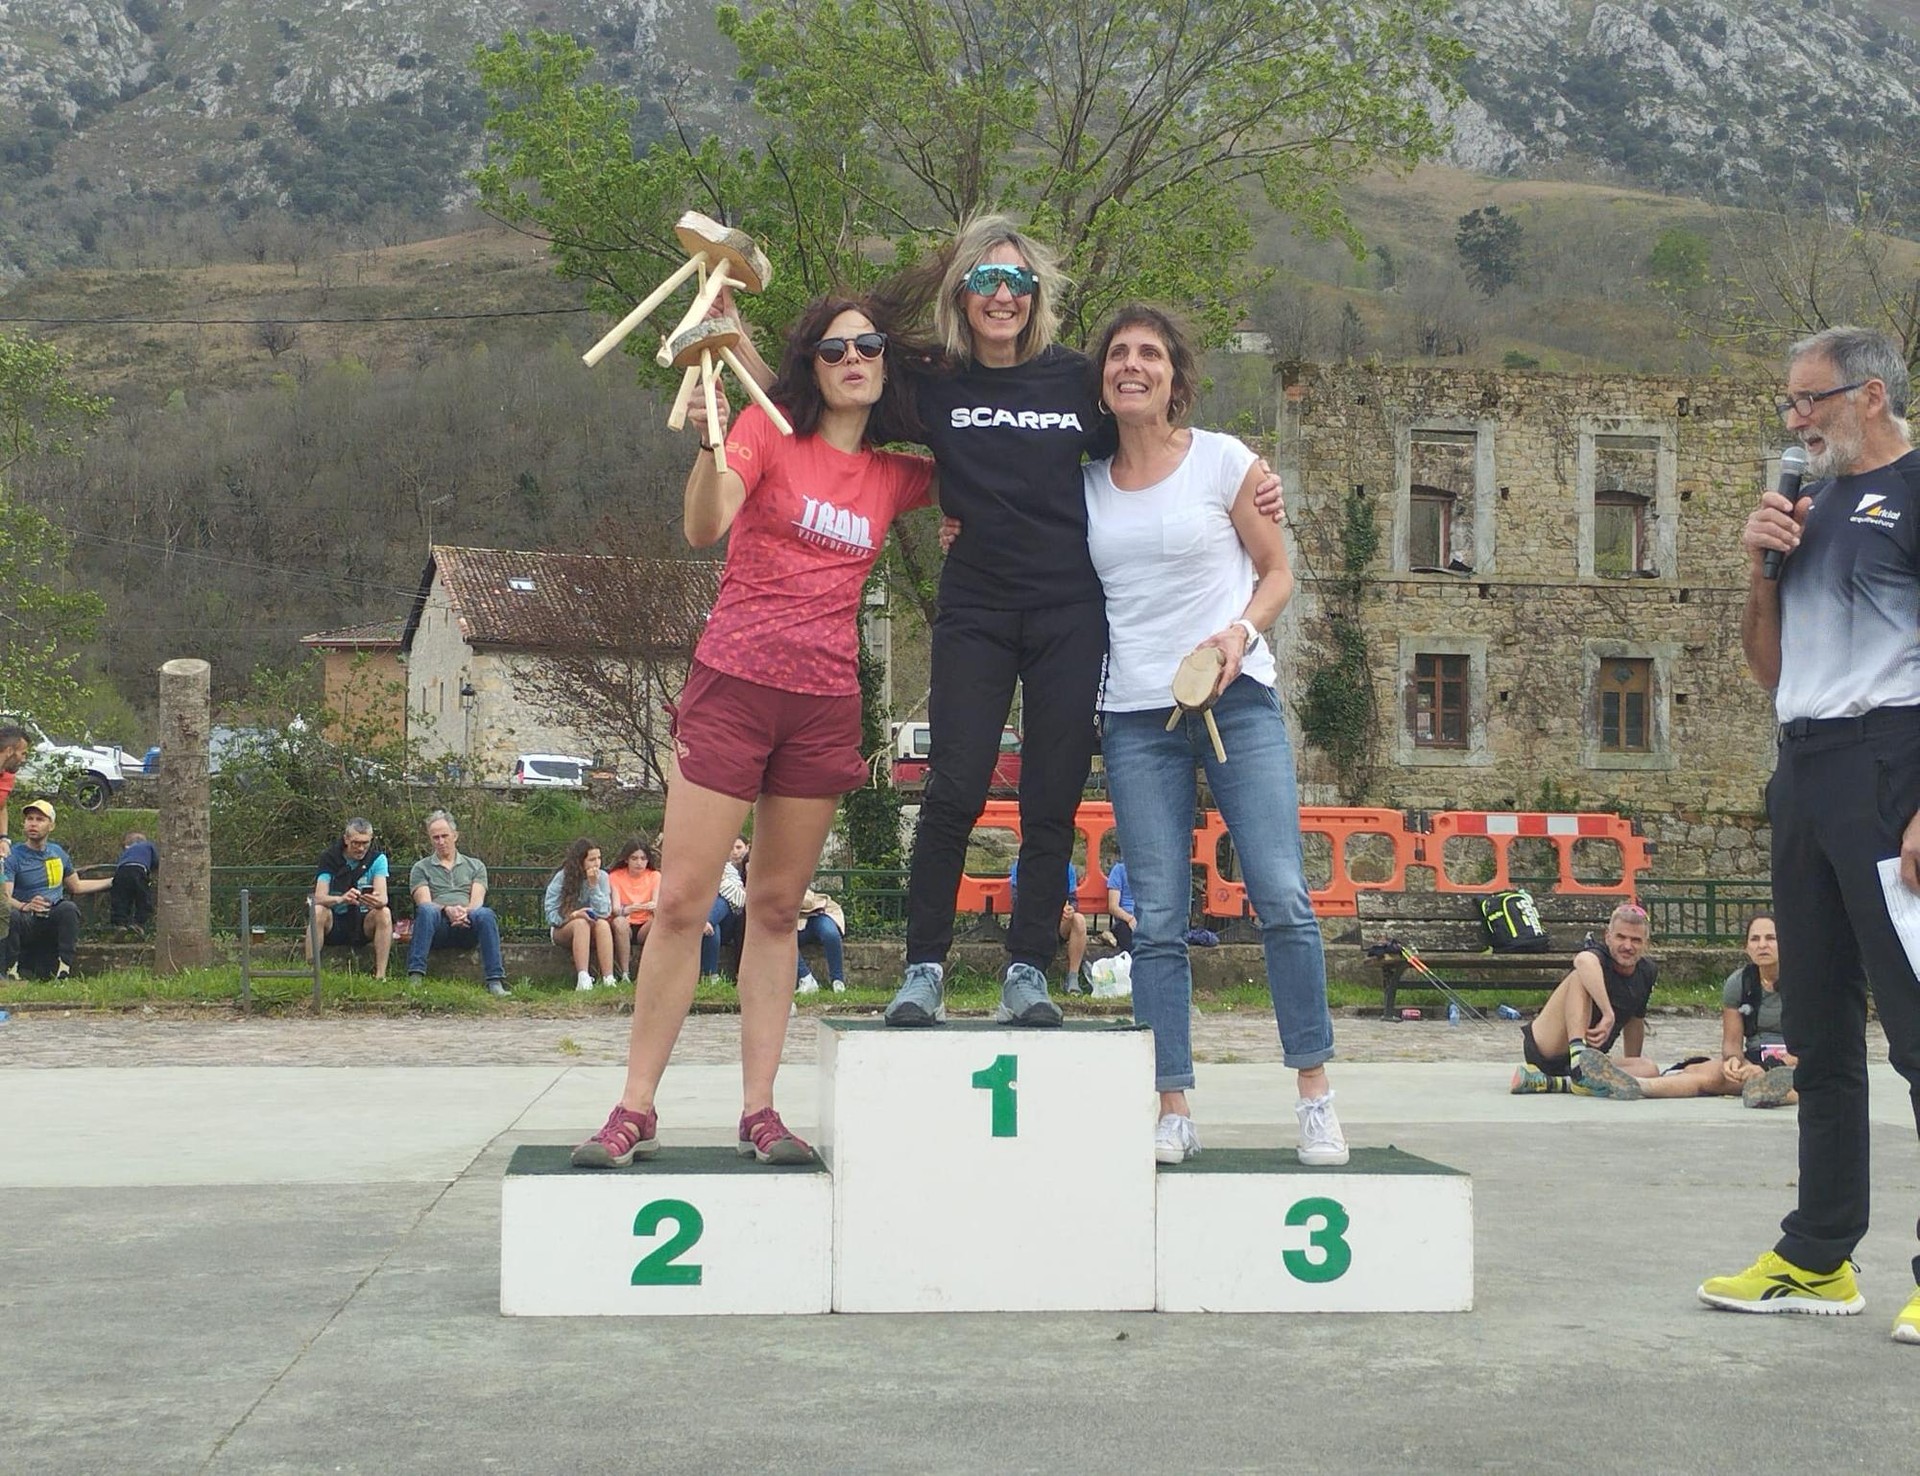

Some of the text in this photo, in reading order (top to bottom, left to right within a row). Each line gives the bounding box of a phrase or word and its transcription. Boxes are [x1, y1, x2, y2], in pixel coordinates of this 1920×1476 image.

[951, 407, 1083, 432] SCARPA
[801, 494, 873, 548] TRAIL
[972, 1054, 1018, 1137] 1
[631, 1199, 704, 1286] 2
[1282, 1197, 1351, 1283] 3
